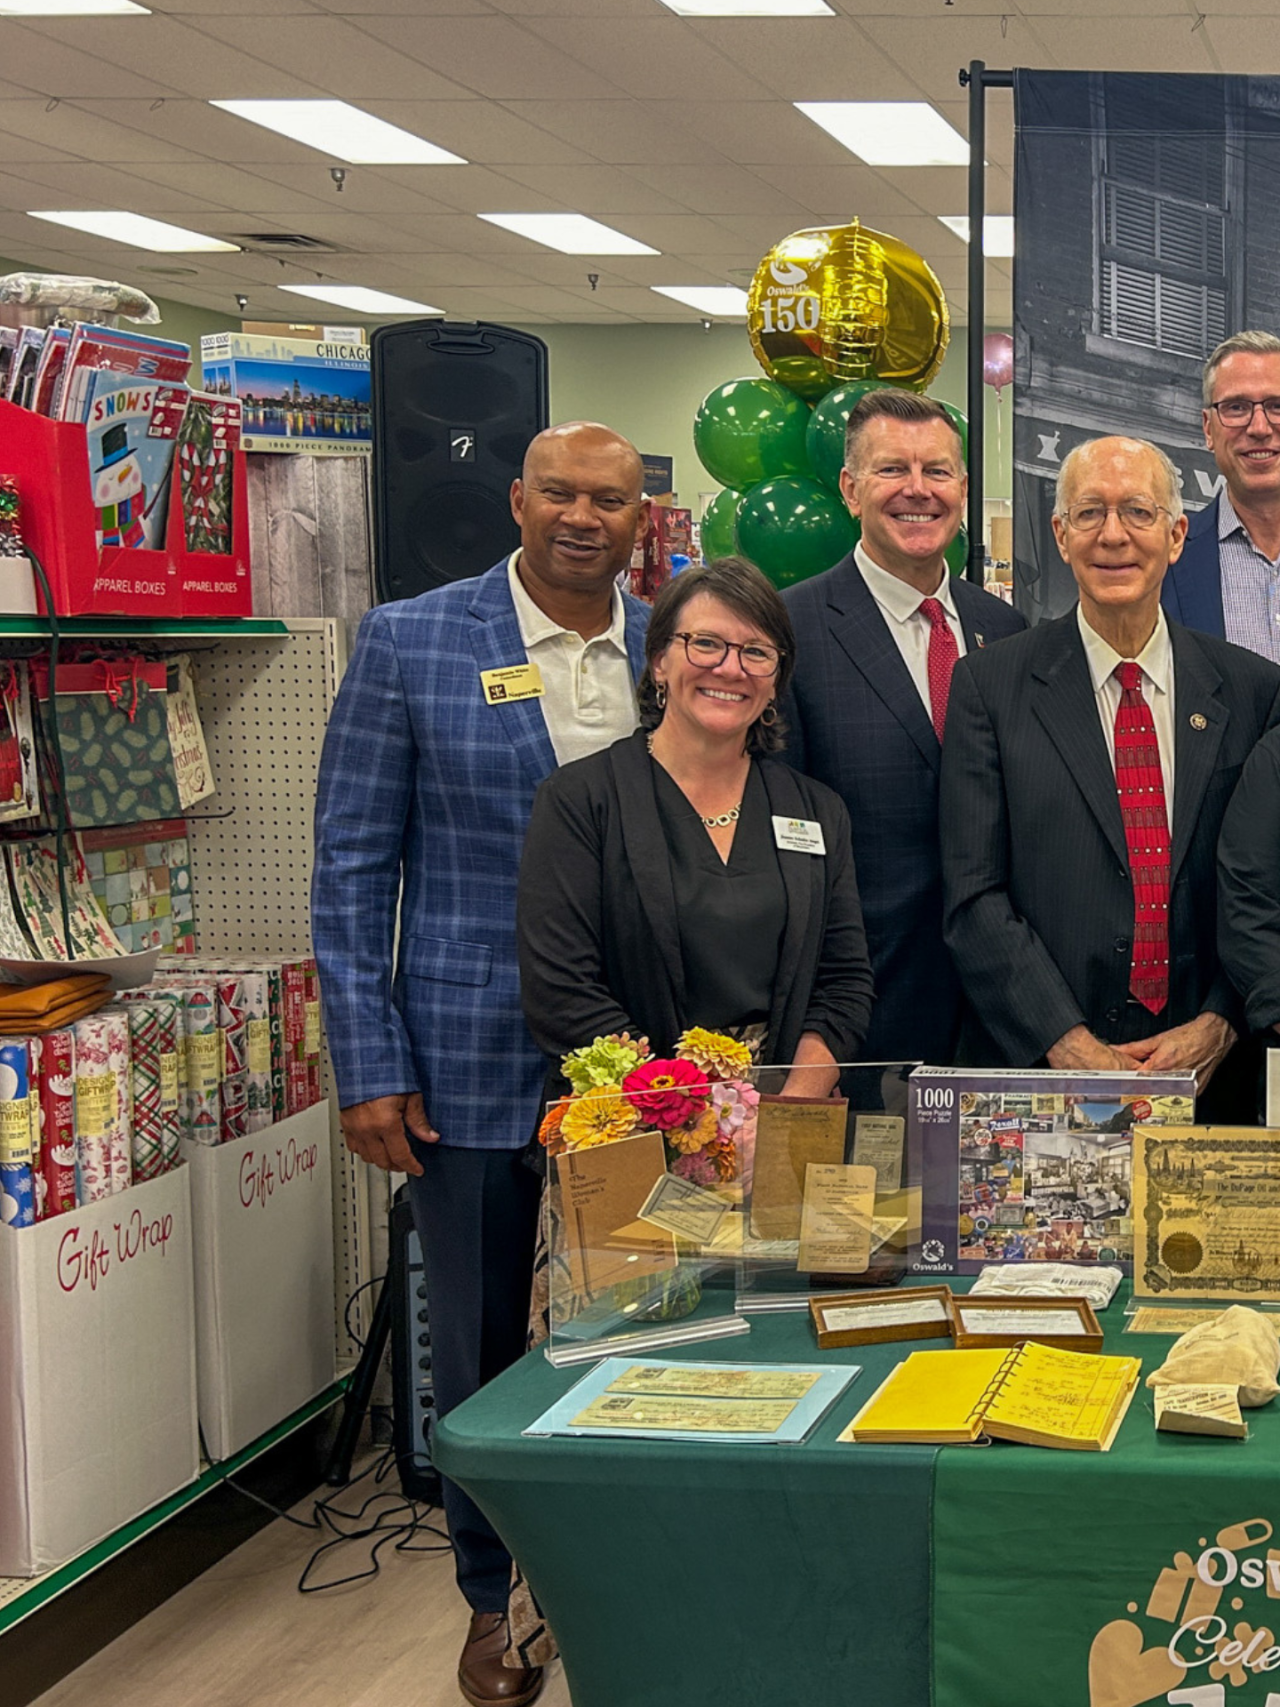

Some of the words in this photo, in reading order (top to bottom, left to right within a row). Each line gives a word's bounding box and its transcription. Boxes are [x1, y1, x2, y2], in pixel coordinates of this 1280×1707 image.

[760, 295, 820, 334] 150
[93, 577, 133, 594] APPAREL
[134, 579, 166, 596] BOXES
[182, 580, 214, 593] APPAREL
[214, 581, 238, 594] BOXES
[915, 1086, 955, 1109] 1000
[933, 1108, 953, 1117] Puzzle
[239, 1150, 275, 1208] Gift
[275, 1137, 318, 1185] Wrap
[1217, 1181, 1230, 1193] The
[1230, 1181, 1256, 1195] DuPage
[1268, 1182, 1280, 1193] and
[57, 1226, 110, 1292] Gift
[113, 1208, 173, 1263] Wrap
[912, 1262, 954, 1272] Oswald's
